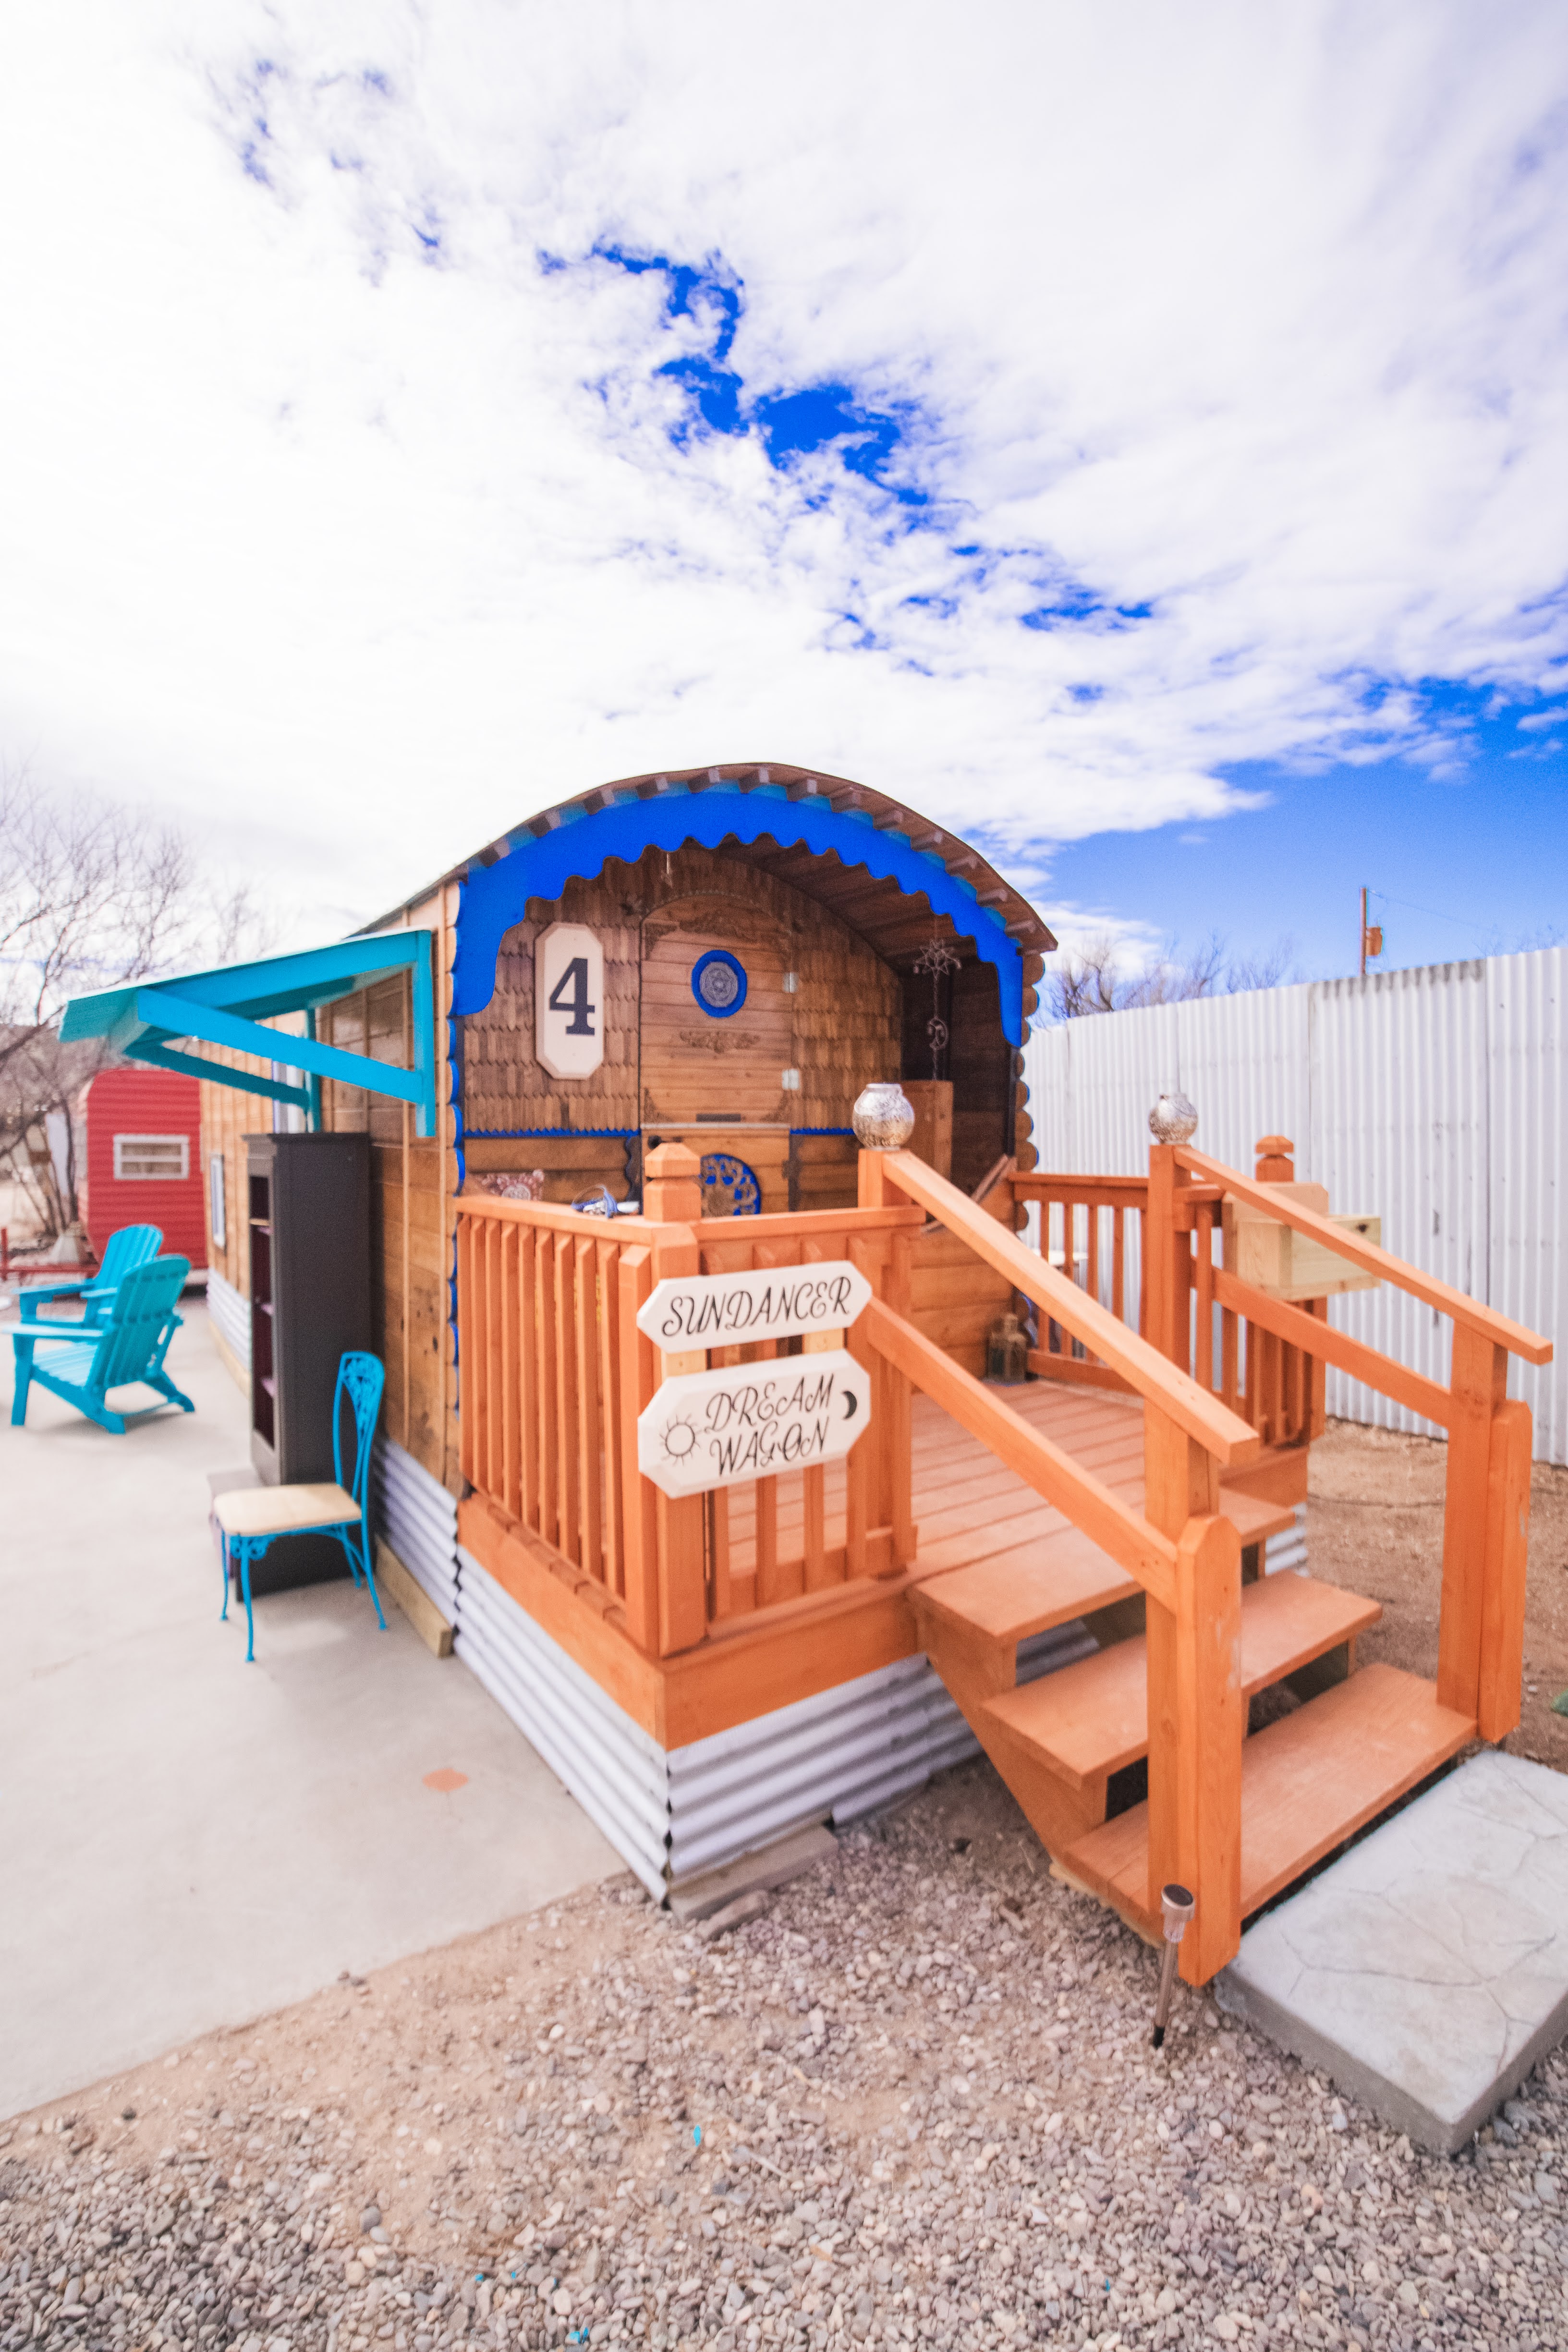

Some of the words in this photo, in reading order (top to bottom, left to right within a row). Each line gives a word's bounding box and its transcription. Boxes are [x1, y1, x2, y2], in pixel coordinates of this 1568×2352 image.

[549, 958, 595, 1035] 4
[662, 1276, 851, 1336] SUNDANCER
[704, 1373, 834, 1433] DREAM
[709, 1416, 829, 1476] WAGON
